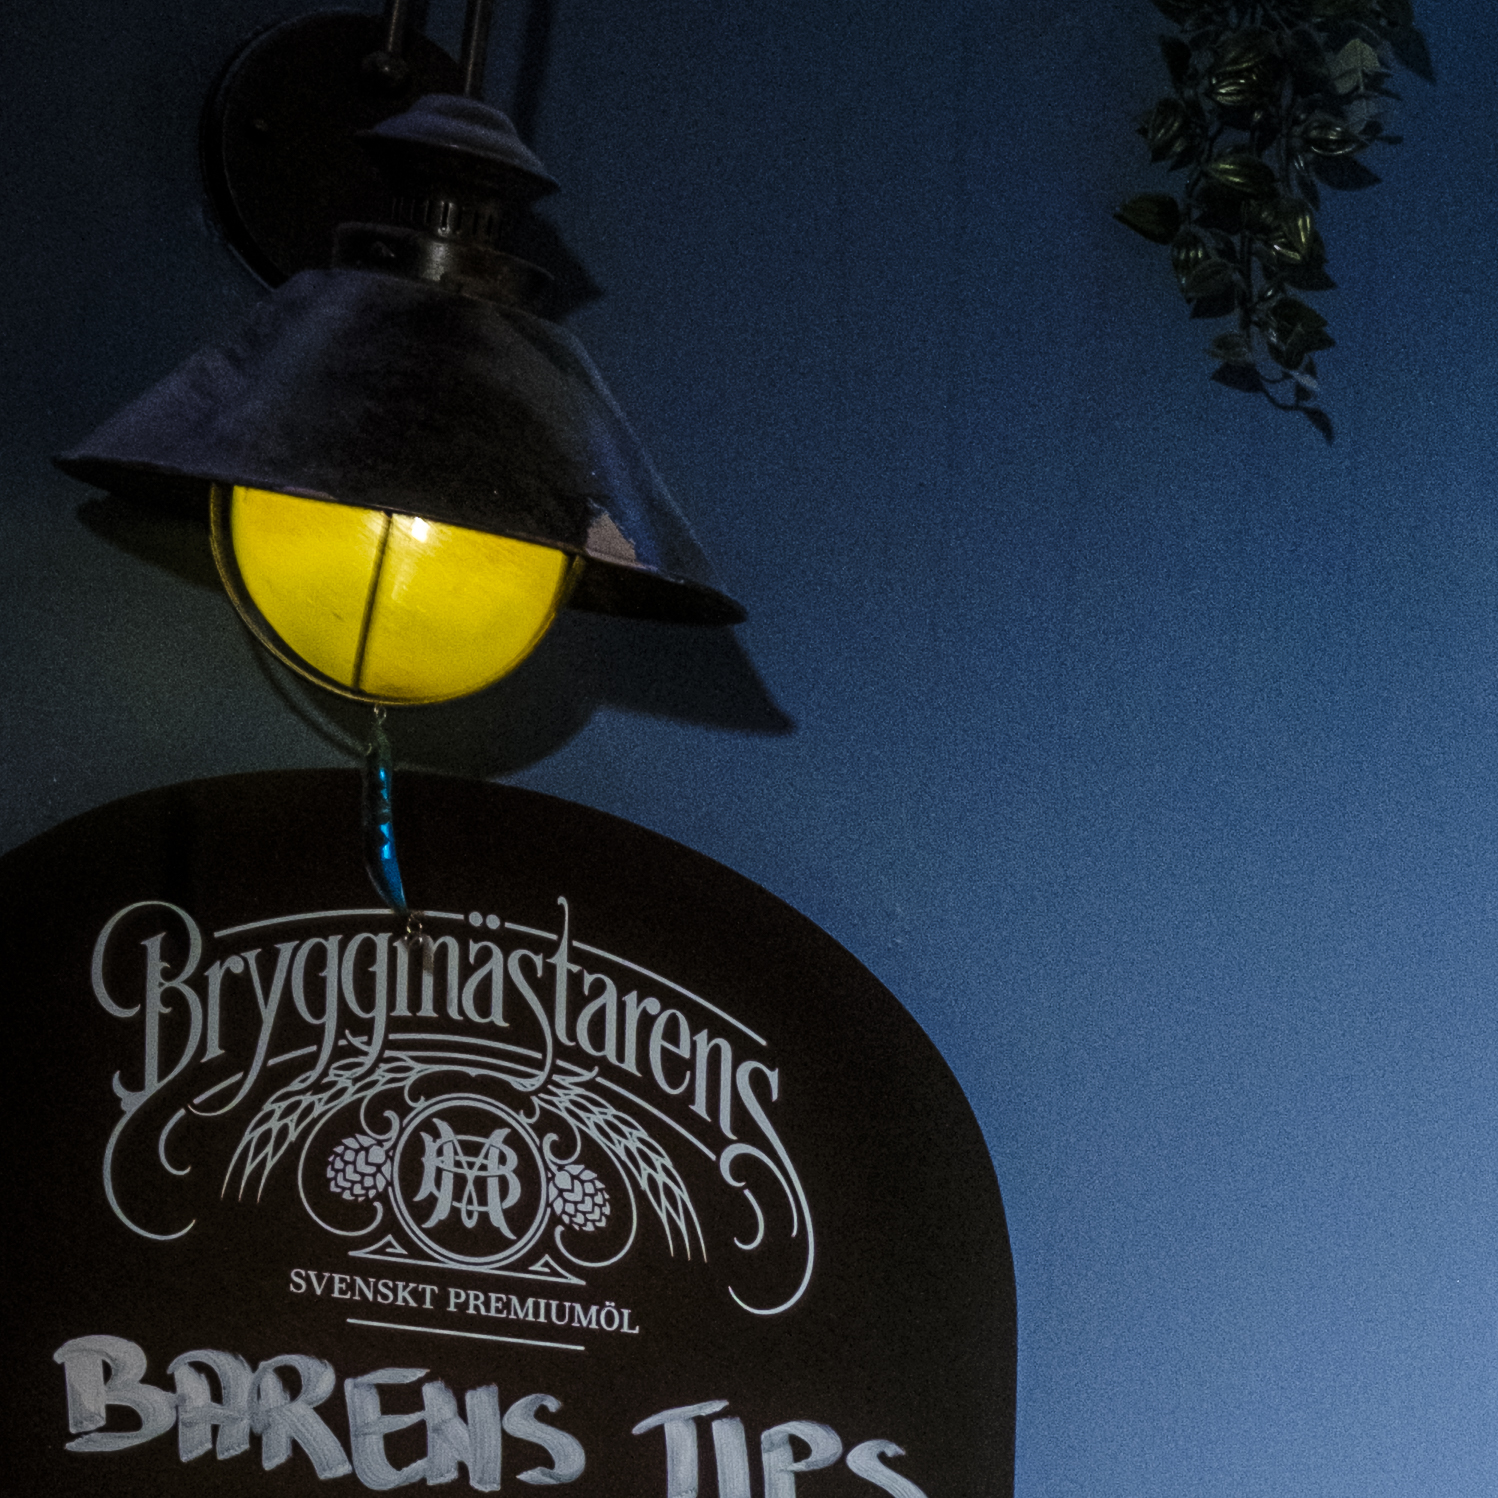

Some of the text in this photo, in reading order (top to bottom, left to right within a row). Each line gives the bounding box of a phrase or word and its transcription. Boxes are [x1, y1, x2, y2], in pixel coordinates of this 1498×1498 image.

[92, 895, 814, 1314] Bryggmästarens
[289, 1268, 640, 1334] SVENSKT PREMIUMÖL
[53, 1333, 586, 1493] BARENS
